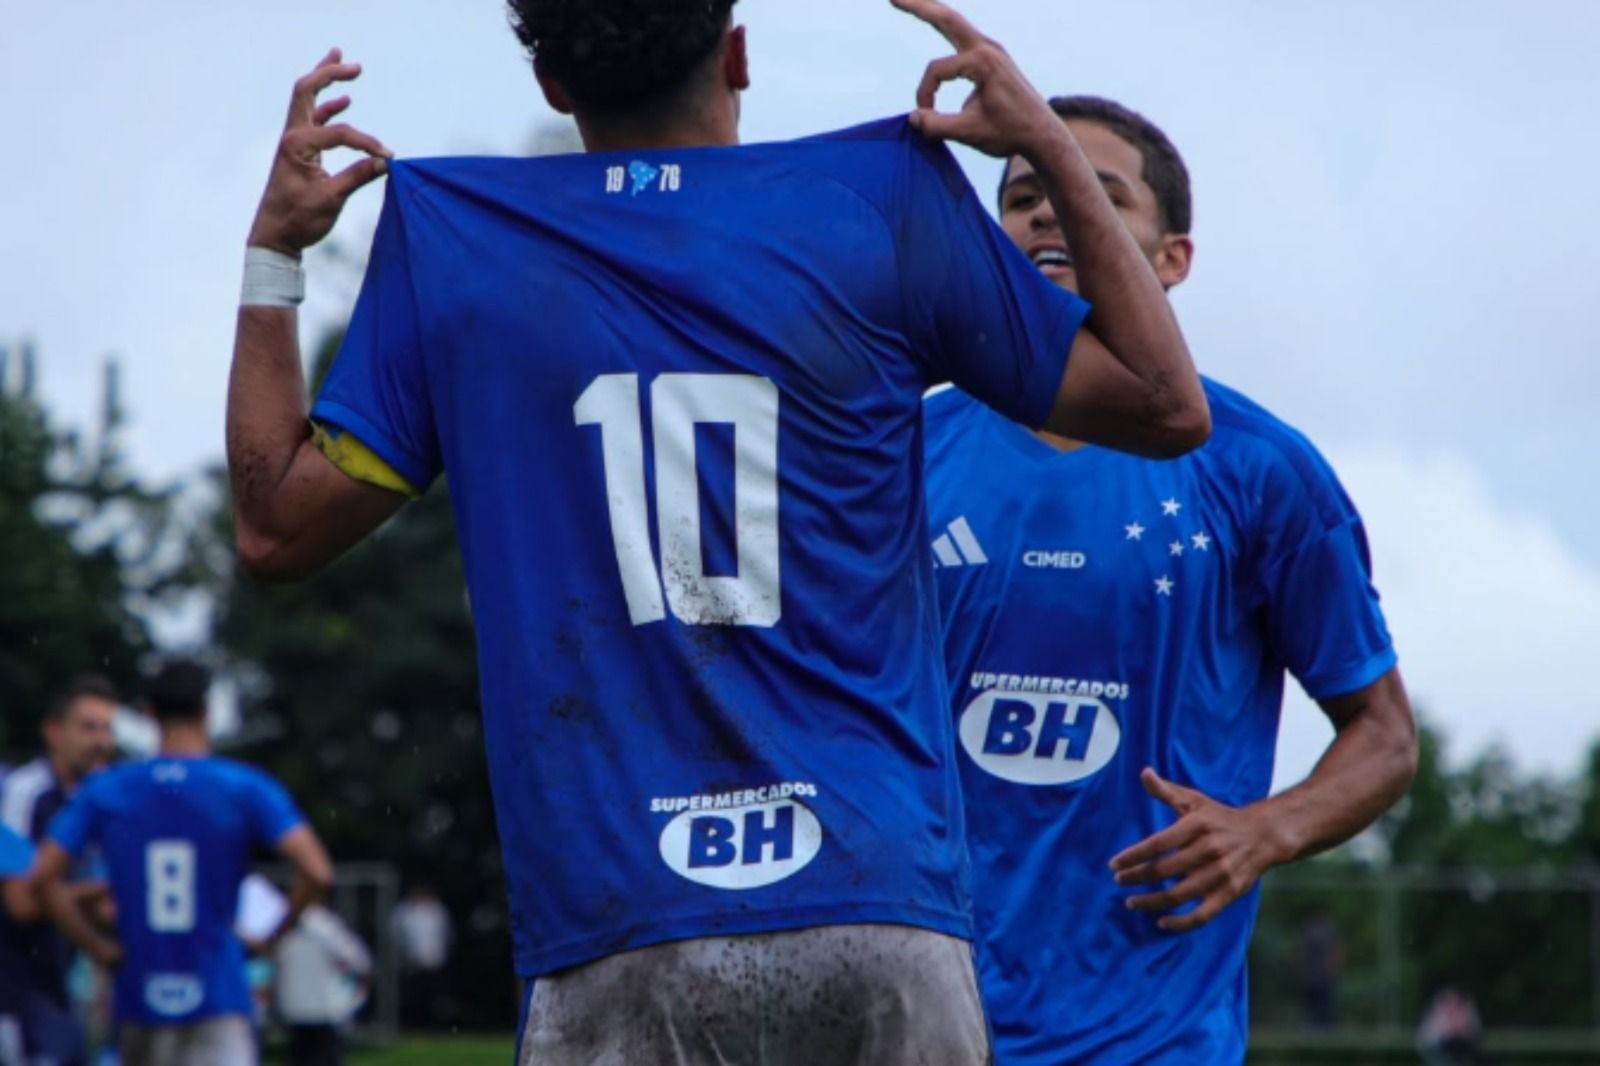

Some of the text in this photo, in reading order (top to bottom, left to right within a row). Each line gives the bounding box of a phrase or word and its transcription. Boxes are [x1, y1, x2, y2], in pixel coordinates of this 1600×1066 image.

[606, 165, 624, 192] 19
[573, 372, 781, 628] 10
[1023, 550, 1086, 569] CIMED
[981, 698, 1099, 762] BH
[650, 782, 817, 812] SUPERMERCADOS
[688, 805, 794, 869] BH
[146, 842, 196, 933] 8
